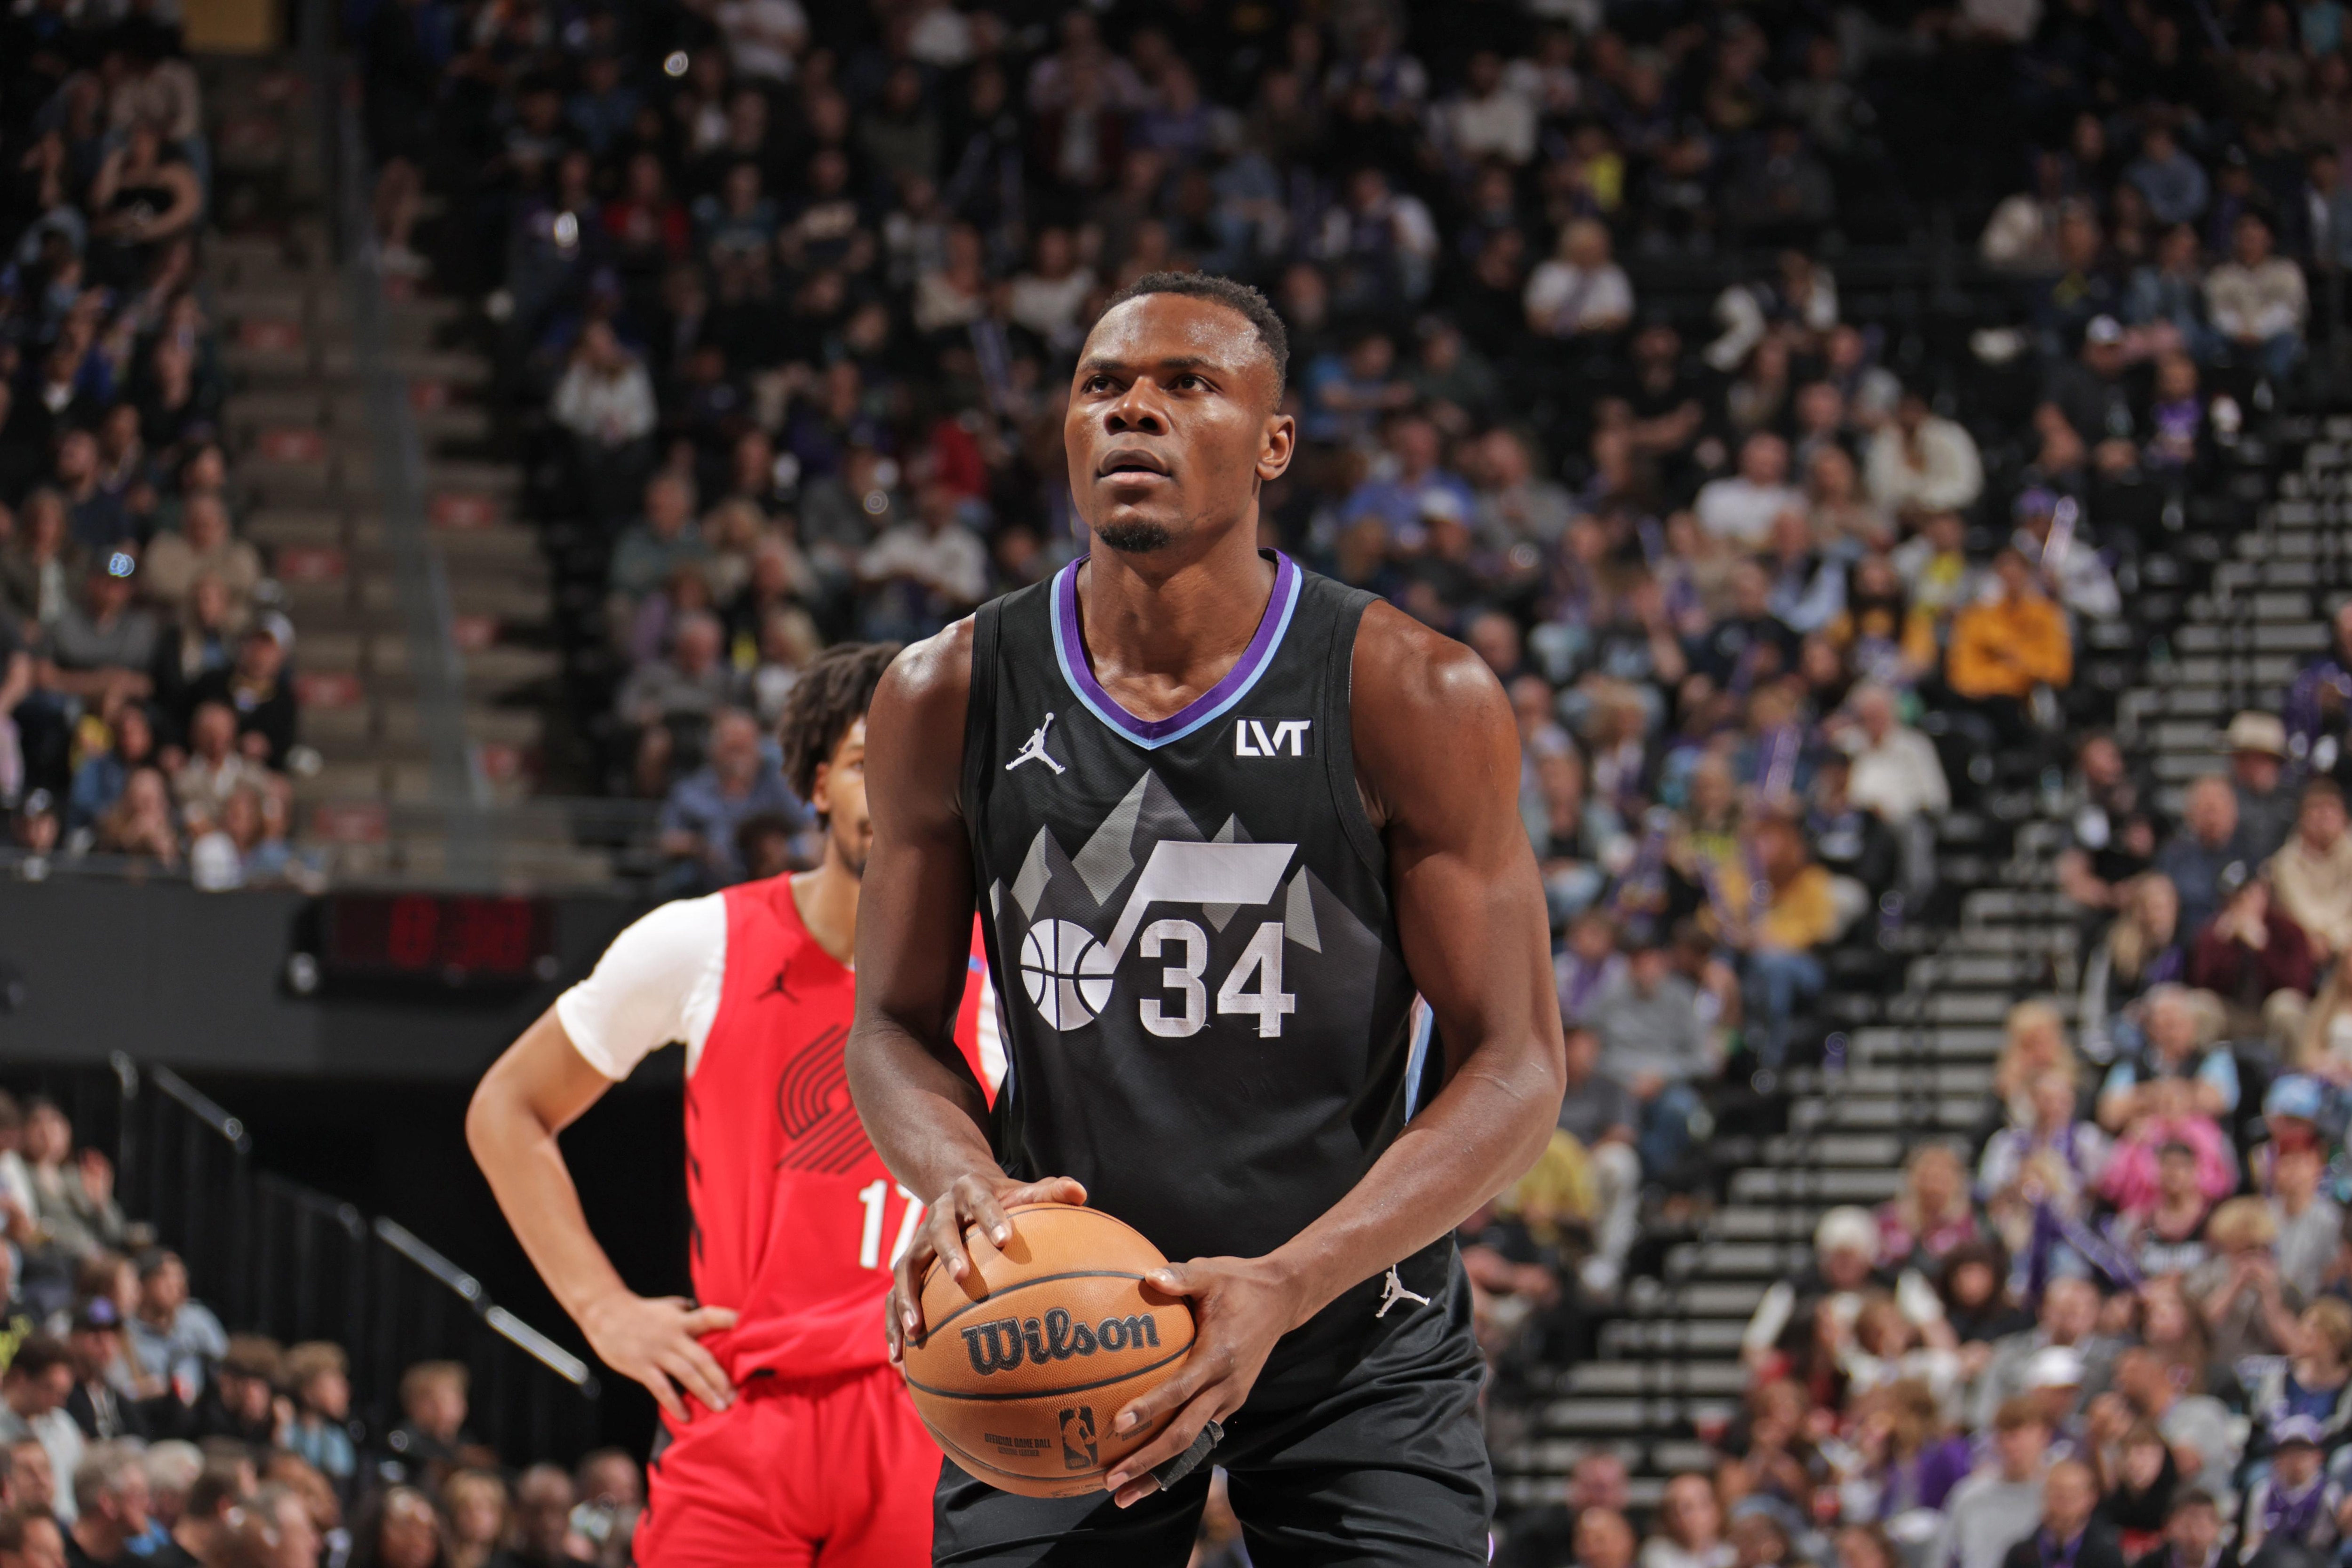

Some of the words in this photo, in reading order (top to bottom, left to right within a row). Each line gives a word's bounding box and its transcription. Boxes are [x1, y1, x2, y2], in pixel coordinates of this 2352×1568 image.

[1236, 719, 1311, 756] LVT
[1139, 919, 1295, 1038] 34
[961, 1307, 1160, 1376] Wilson
[985, 1433, 1014, 1447] OFFICIAL
[1014, 1437, 1033, 1448] GAME
[1034, 1438, 1051, 1448] BALL
